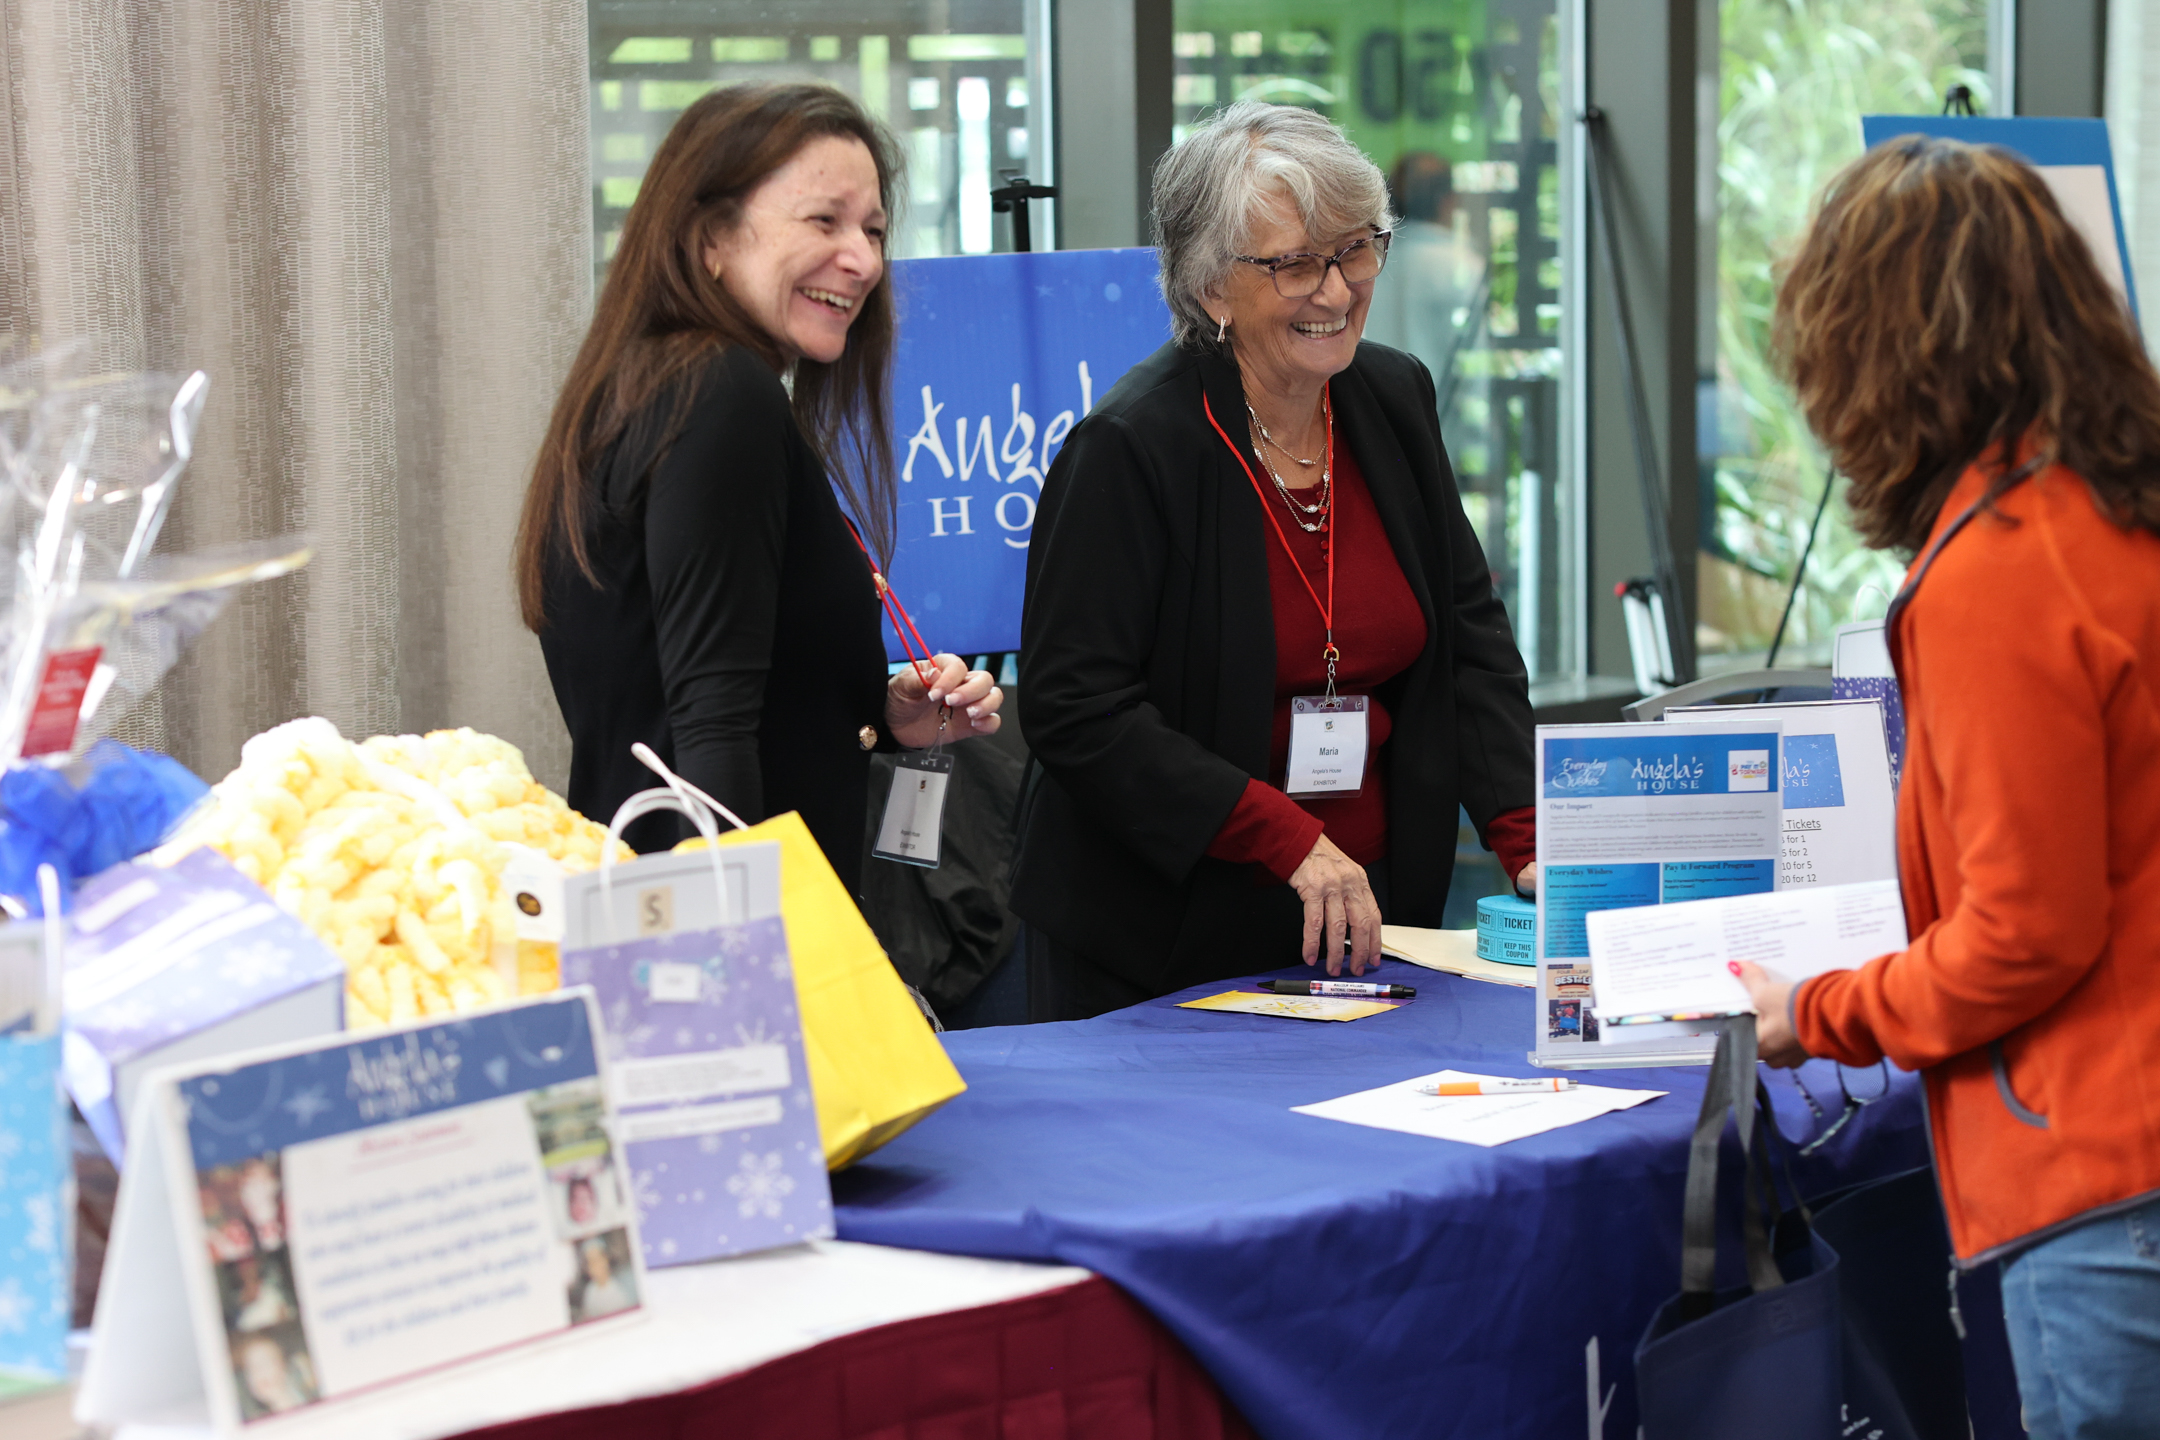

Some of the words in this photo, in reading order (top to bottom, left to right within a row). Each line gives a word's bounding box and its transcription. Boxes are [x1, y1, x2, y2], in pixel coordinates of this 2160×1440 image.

[1319, 746, 1339, 756] Maria
[1561, 757, 1608, 776] Everyday
[1631, 753, 1704, 781] Angela's
[1637, 779, 1700, 791] HOUSE
[1786, 819, 1822, 829] Tickets
[1786, 835, 1799, 844] for
[1800, 835, 1806, 843] 1
[1789, 848, 1801, 857] for
[1802, 847, 1809, 856] 2
[1664, 864, 1678, 872] Pay
[1689, 862, 1721, 870] Forward
[1723, 862, 1755, 871] Program
[1793, 861, 1805, 870] for
[1806, 860, 1813, 870] 5
[1548, 868, 1584, 877] Everyday
[1792, 874, 1805, 883] for
[1806, 873, 1817, 883] 12
[643, 893, 664, 927] S
[1504, 917, 1533, 930] TICKET
[1504, 942, 1517, 950] KEEP
[1518, 943, 1532, 952] THIS
[1505, 950, 1529, 959] COUPON
[1554, 975, 1578, 985] BEST
